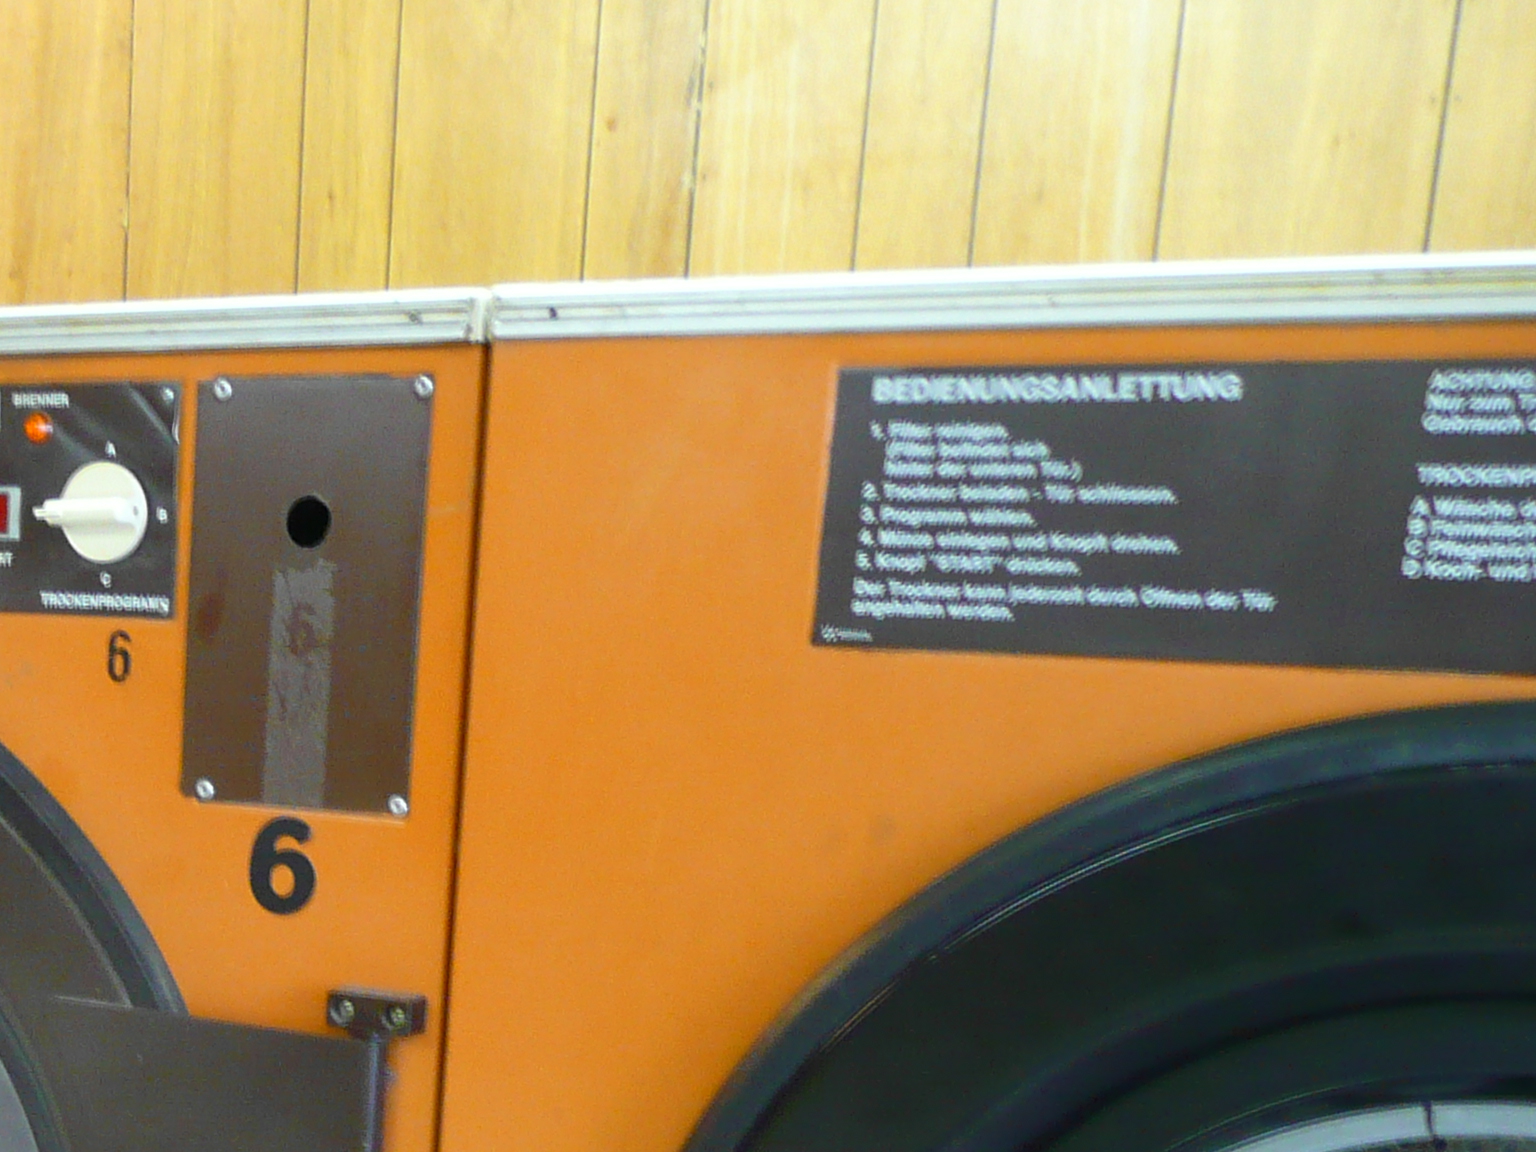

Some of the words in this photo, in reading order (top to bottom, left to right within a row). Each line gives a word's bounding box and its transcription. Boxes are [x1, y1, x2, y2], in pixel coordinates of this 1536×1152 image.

[11, 392, 70, 409] BRENNER
[105, 440, 118, 458] A
[861, 481, 881, 502] 2.
[155, 504, 169, 524] B
[860, 505, 878, 524] 3.
[1410, 495, 1429, 515] A
[1407, 516, 1428, 537] B
[857, 528, 876, 548] 4.
[1404, 537, 1426, 558] C
[855, 549, 874, 571] 5.
[1401, 556, 1422, 579] D
[99, 571, 112, 589] C
[853, 576, 886, 597] Der
[107, 629, 132, 682] 6
[249, 815, 317, 917] 6
